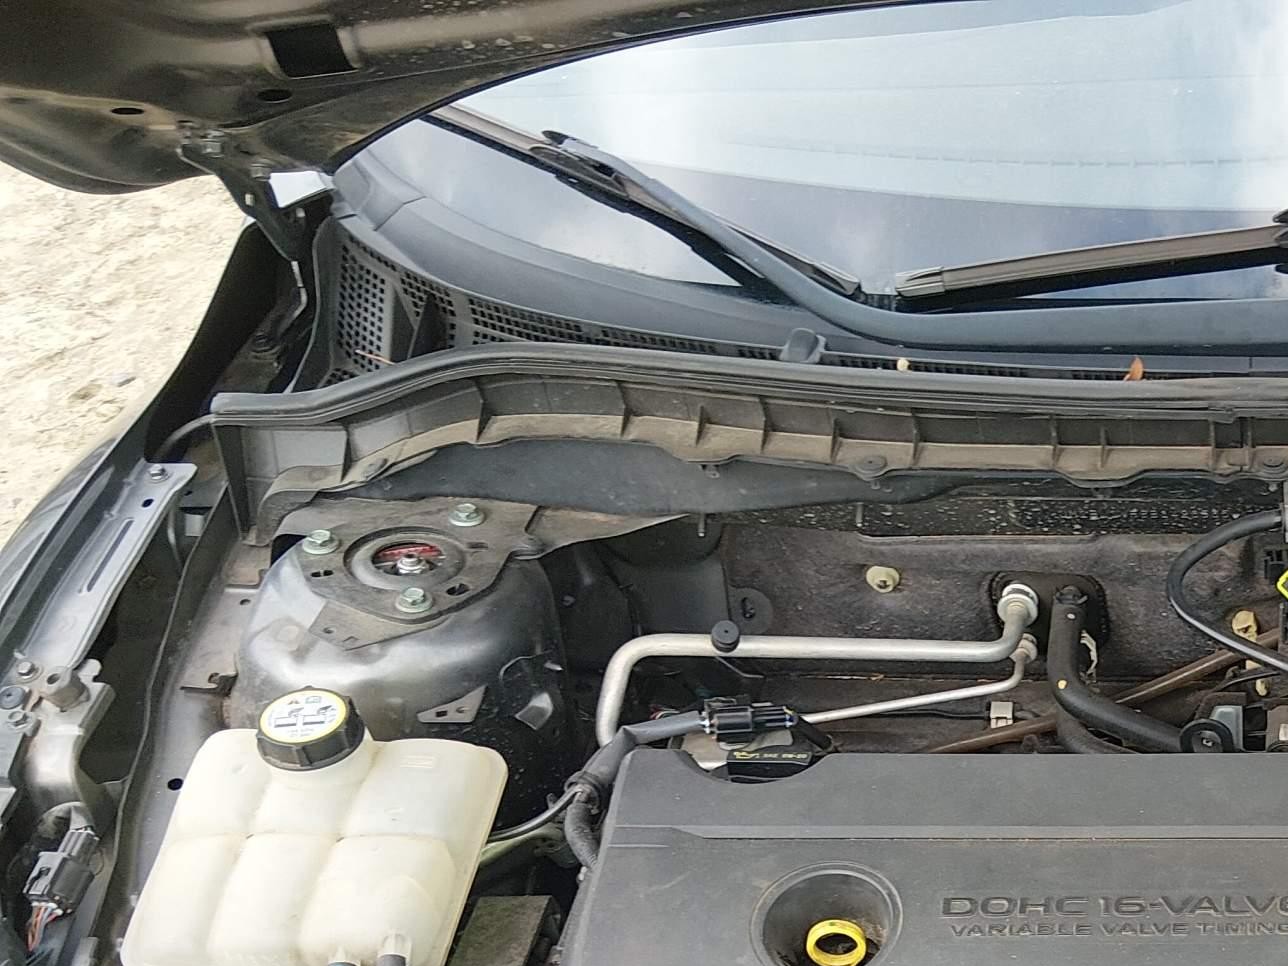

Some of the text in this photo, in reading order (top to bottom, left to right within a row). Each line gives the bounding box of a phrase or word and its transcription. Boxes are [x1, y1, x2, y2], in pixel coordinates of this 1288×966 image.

[940, 895, 1089, 918] DOHC
[950, 922, 1092, 938] VARIABLE
[1099, 922, 1190, 937] VALVE
